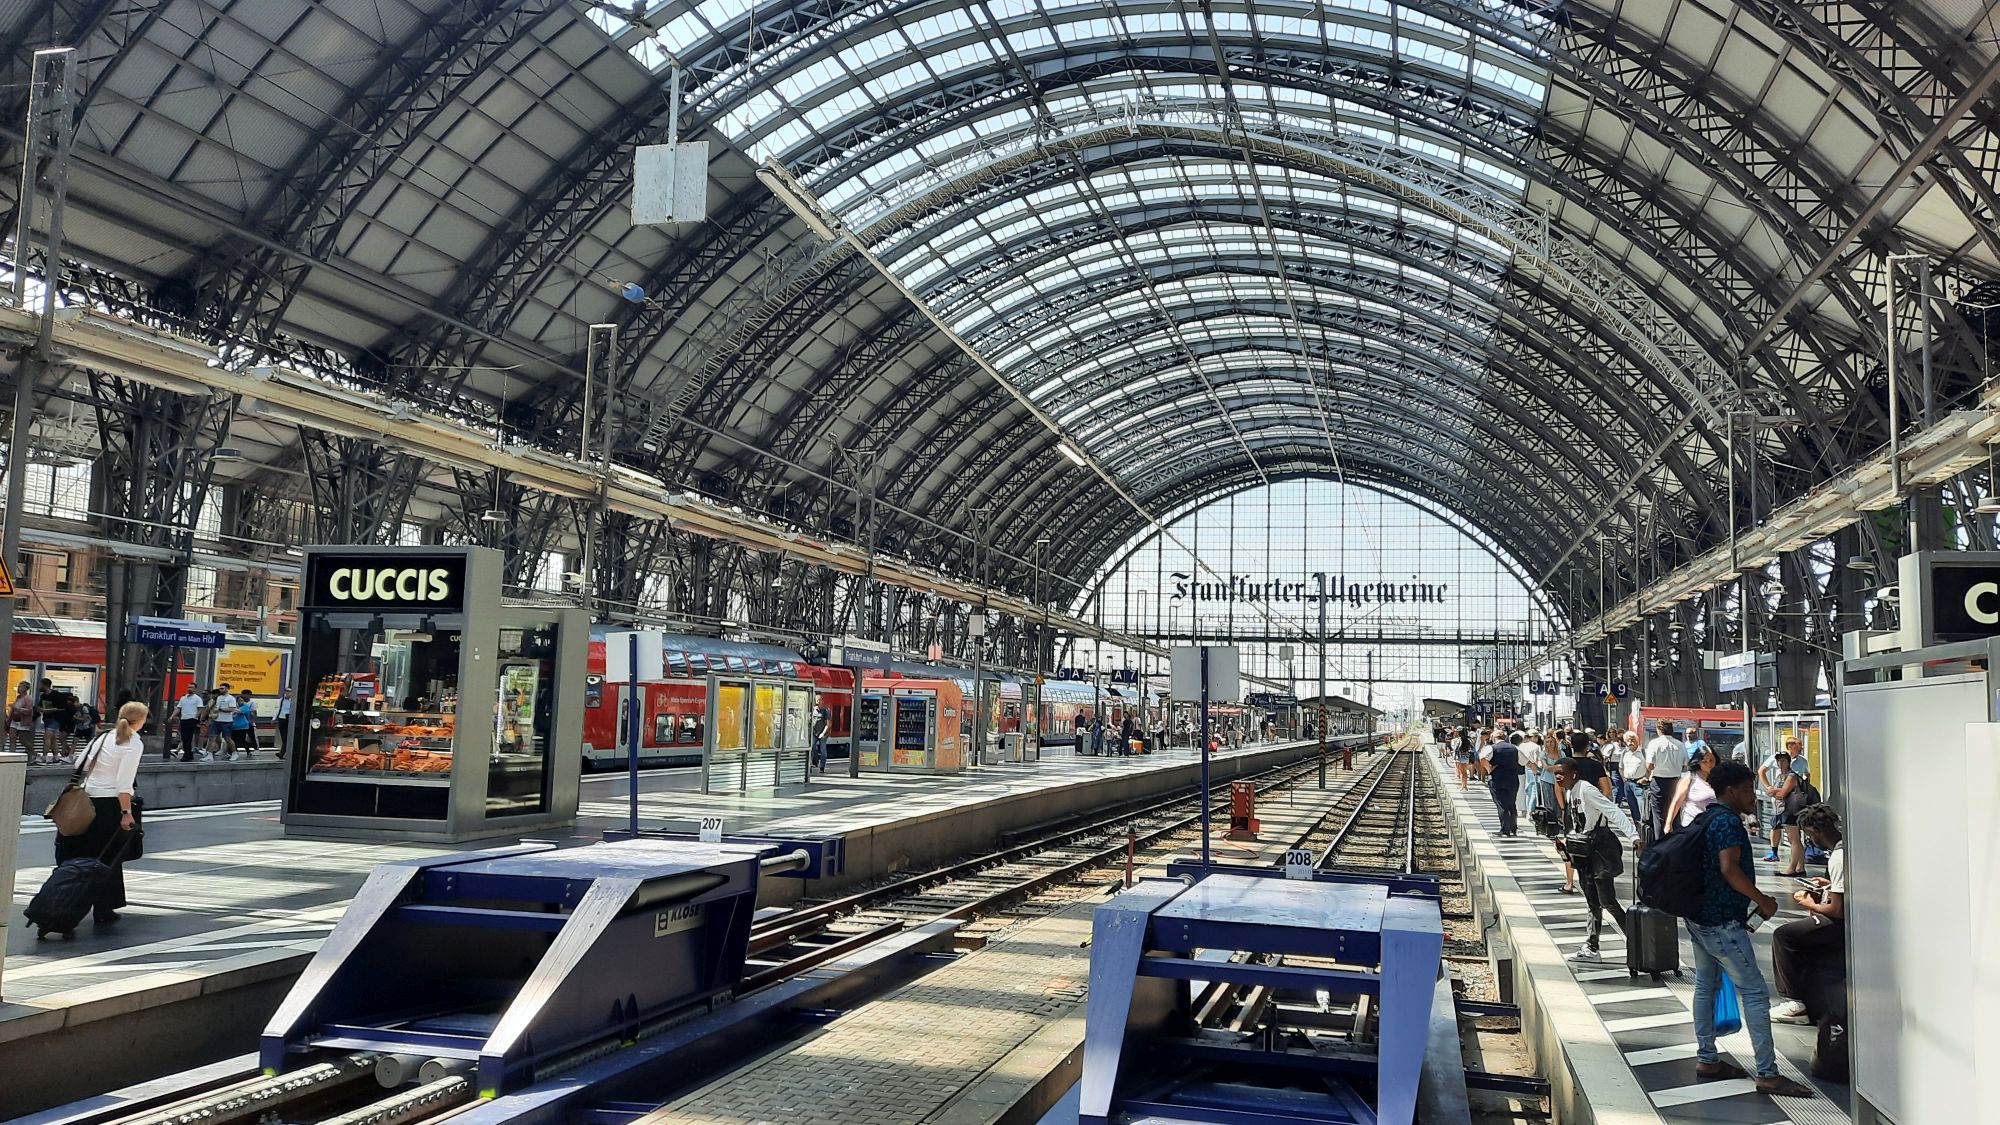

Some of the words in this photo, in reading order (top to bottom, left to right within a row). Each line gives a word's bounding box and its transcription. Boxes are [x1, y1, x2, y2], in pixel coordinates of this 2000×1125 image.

[330, 568, 449, 600] CUCCIS
[1170, 572, 1304, 606] Frankfurter
[1307, 572, 1447, 608] Allgemeine
[1964, 582, 1998, 624] C
[1306, 614, 1418, 625] DUSCHLAND
[142, 629, 176, 641] Frankfurt
[202, 634, 216, 644] Hbf
[1058, 668, 1065, 678] 6
[1071, 669, 1080, 678] A
[1114, 670, 1122, 680] A
[1129, 670, 1137, 680] 7
[1531, 681, 1539, 692] 8
[1547, 681, 1557, 692] A
[1600, 684, 1608, 694] A
[1618, 684, 1626, 696] 9
[702, 817, 722, 830] 207
[1287, 851, 1312, 866] 208
[671, 904, 700, 922] KLOSE
